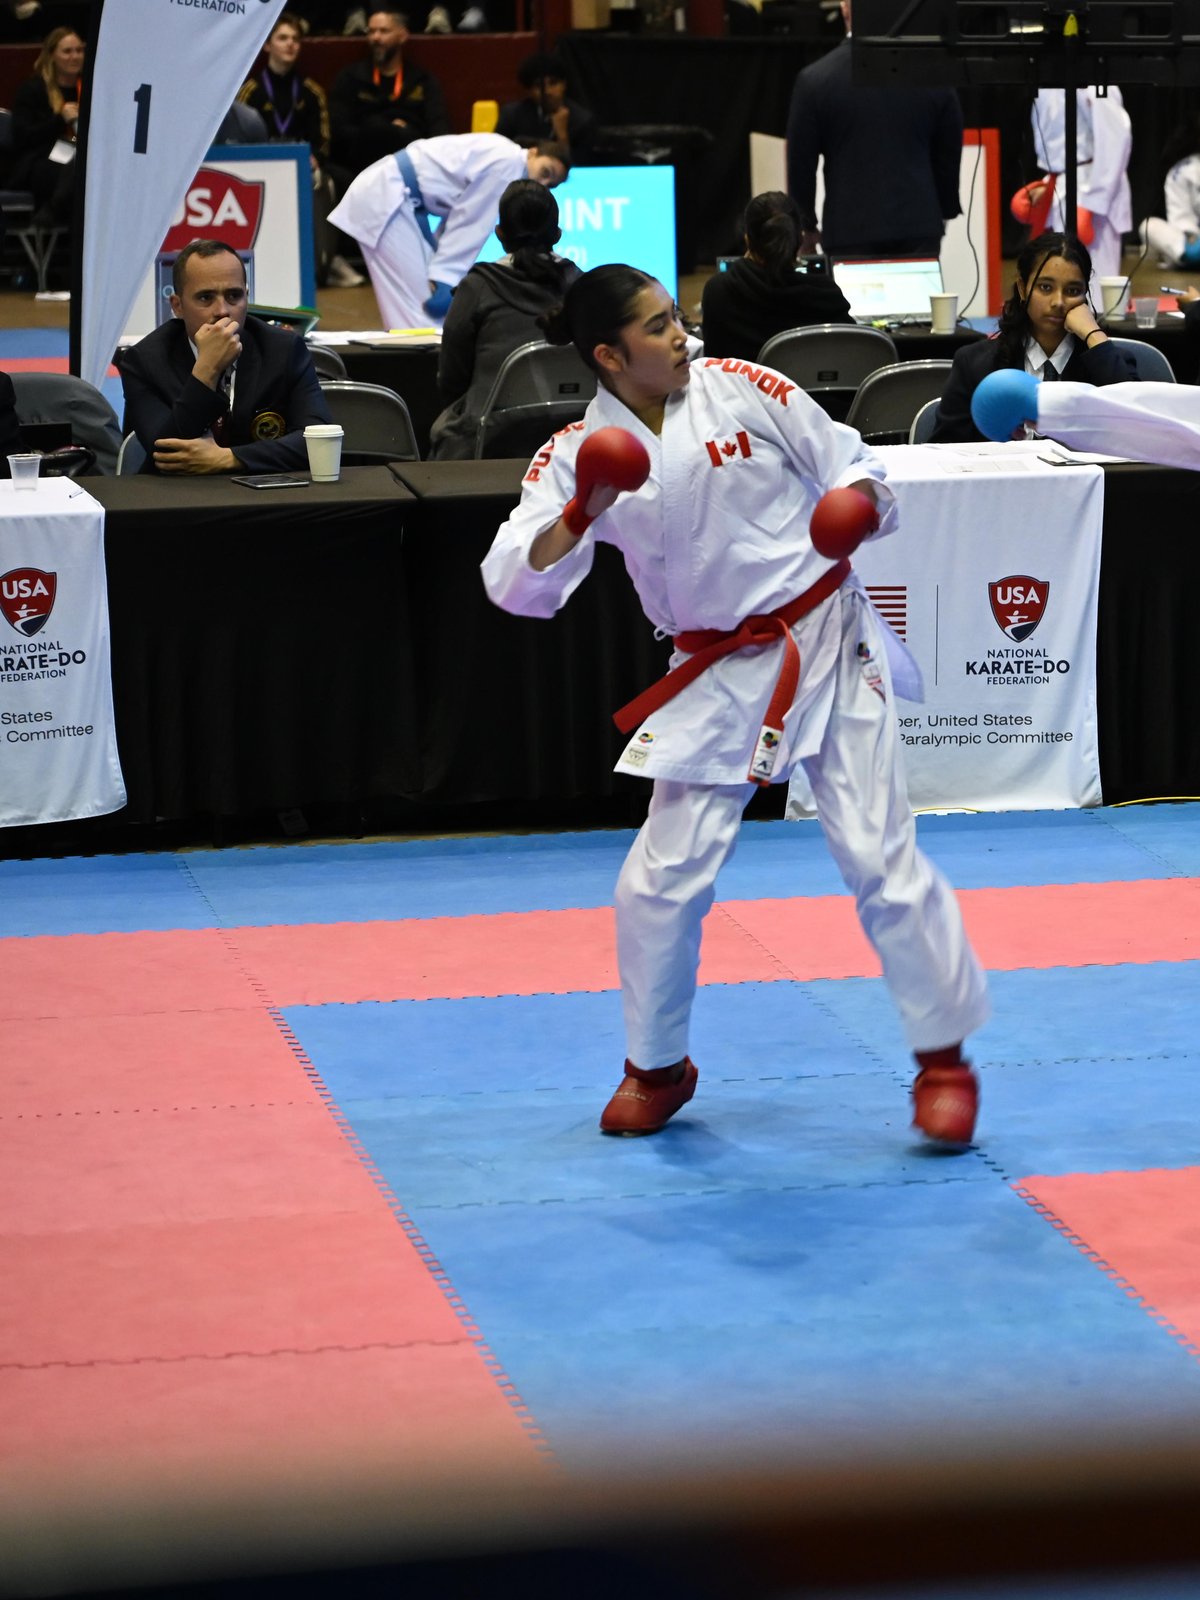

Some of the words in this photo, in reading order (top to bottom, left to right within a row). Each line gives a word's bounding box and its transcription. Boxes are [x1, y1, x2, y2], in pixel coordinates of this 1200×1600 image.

[133, 83, 152, 154] 1
[704, 358, 796, 407] PUNOK
[2, 578, 49, 599] USA
[997, 586, 1040, 604] USA
[0, 641, 63, 655] NATIONAL
[987, 648, 1049, 659] NATIONAL
[0, 650, 86, 672] RATE-DO
[965, 660, 1070, 675] KARATE-DO
[1, 669, 66, 683] FEDERATION
[987, 676, 1049, 685] FEDERATION
[1, 711, 53, 724] States
[928, 714, 978, 727] United
[983, 714, 1033, 726] States
[6, 725, 94, 743] Committee
[987, 731, 1073, 744] Committee
